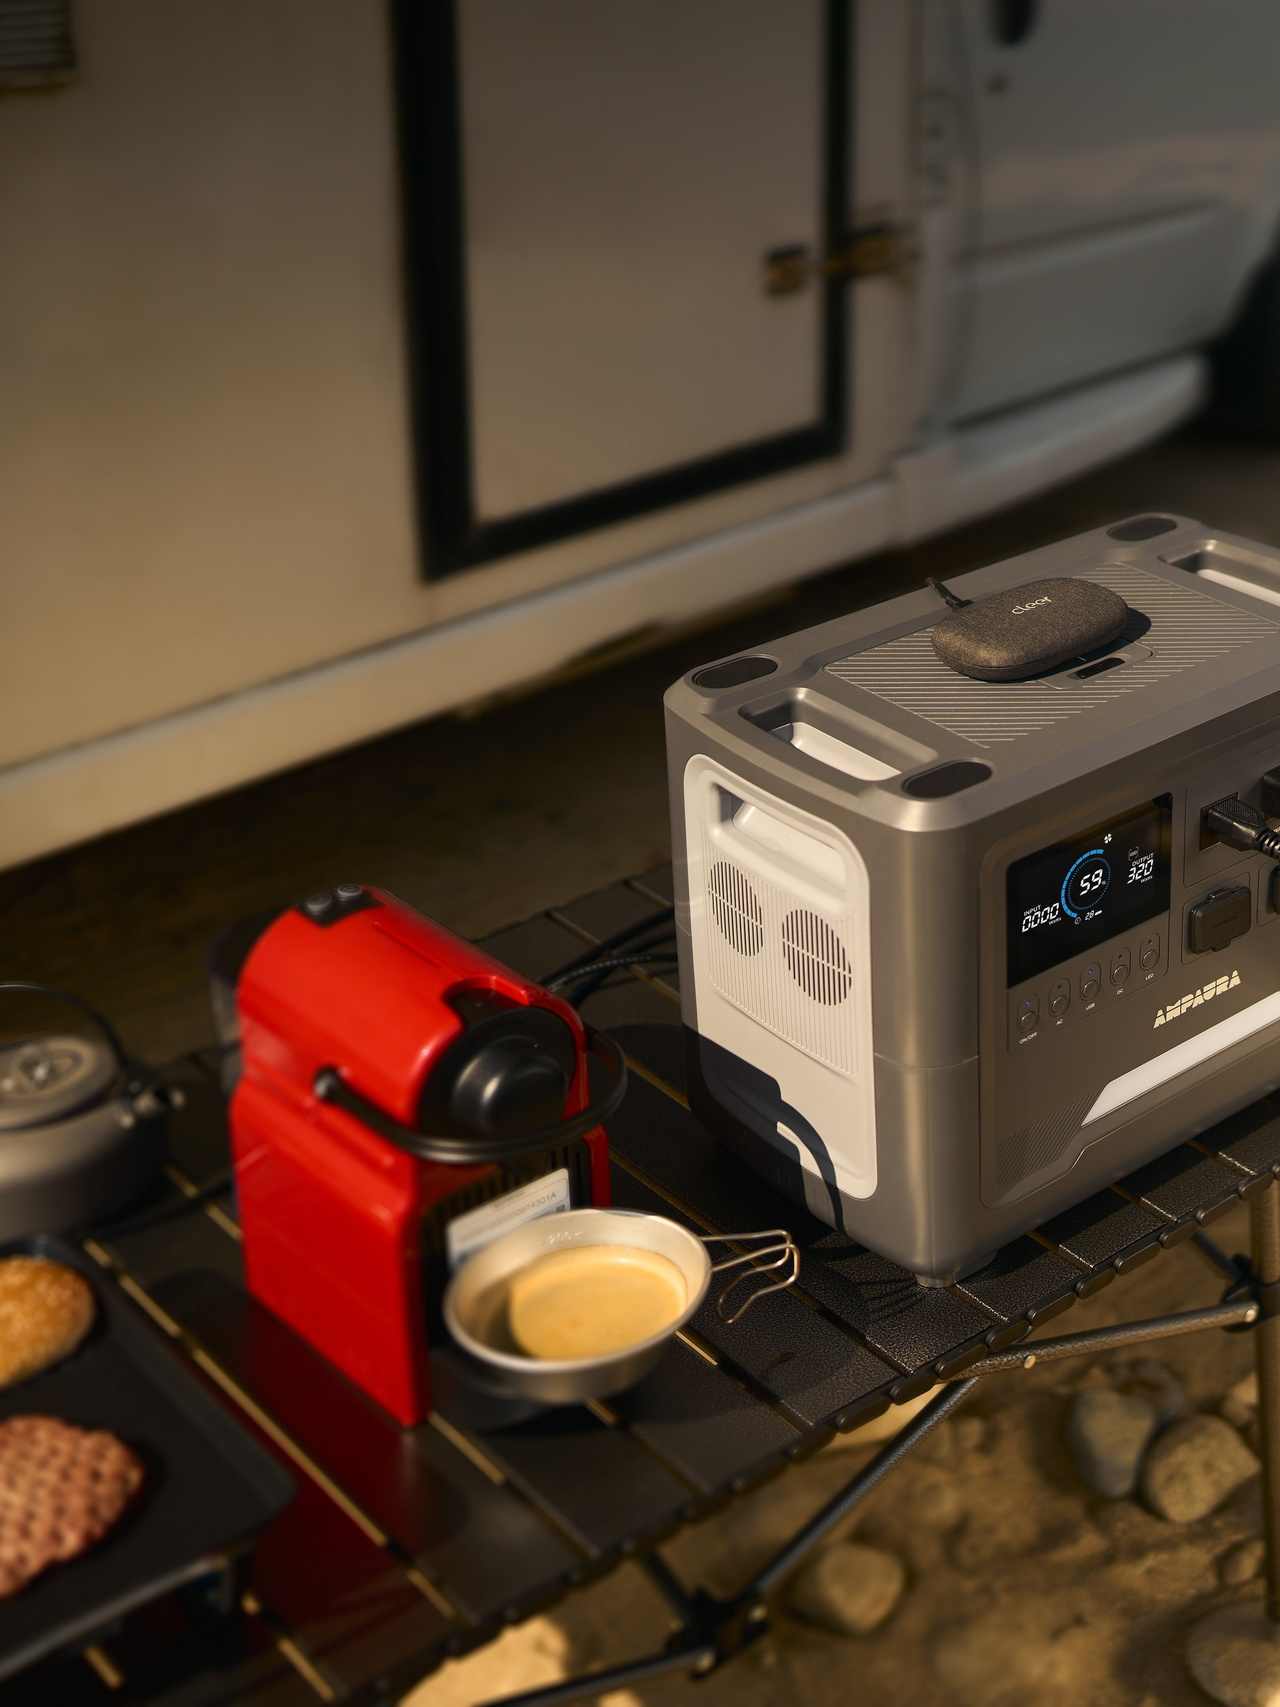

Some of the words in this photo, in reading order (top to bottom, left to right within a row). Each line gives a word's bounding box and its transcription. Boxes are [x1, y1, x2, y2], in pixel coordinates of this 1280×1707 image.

[1011, 595, 1052, 615] cleer
[1131, 852, 1155, 867] OUTPUT
[1127, 858, 1154, 885] 320
[1021, 902, 1060, 933] 0000
[1023, 904, 1041, 917] INPUT
[1145, 972, 1155, 981] LED
[1116, 987, 1124, 995] DC
[1153, 969, 1241, 1029] AMPAURA
[1085, 1002, 1096, 1011] USB
[1055, 1018, 1064, 1026] AC
[1019, 1031, 1038, 1045] ON/OFF
